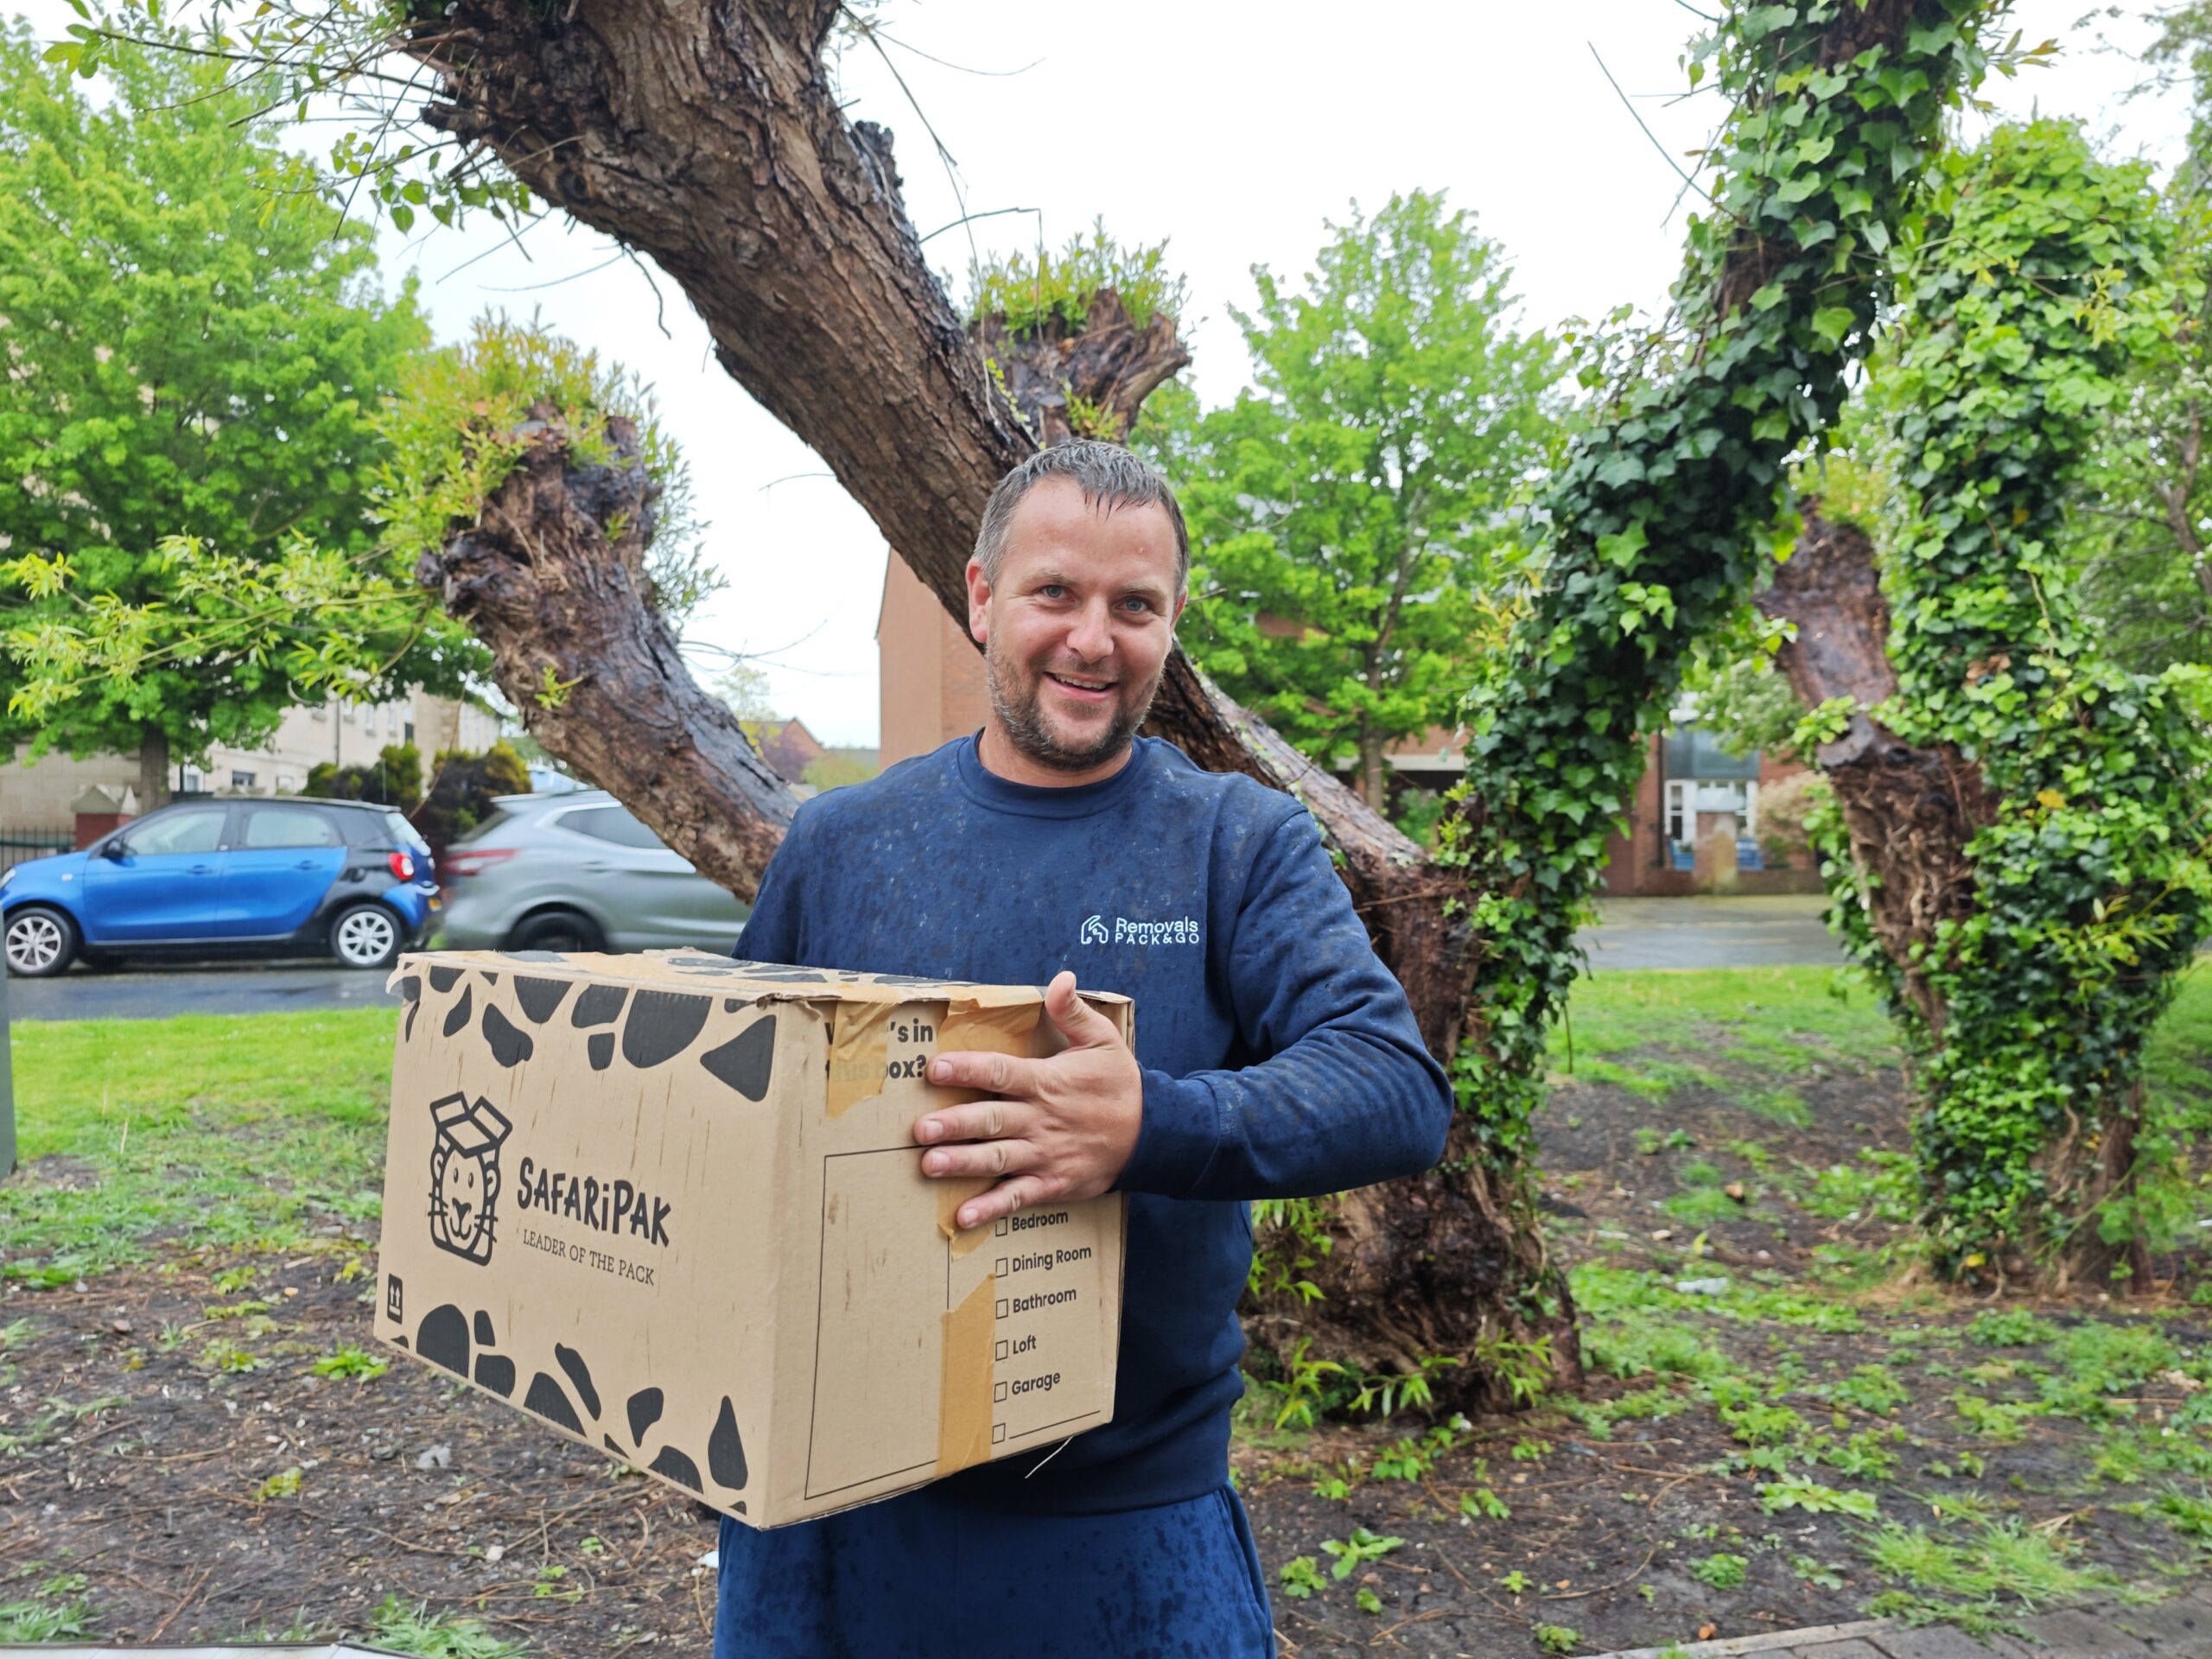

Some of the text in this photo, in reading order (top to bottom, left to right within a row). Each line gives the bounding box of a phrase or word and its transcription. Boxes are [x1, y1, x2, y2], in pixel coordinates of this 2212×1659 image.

[1116, 916, 1198, 934] Removals
[1116, 932, 1199, 944] PACK&GO
[913, 1018, 933, 1042] in
[1012, 1211, 1068, 1232] Bedroom
[523, 1229, 654, 1286] LEADER OF THE PACK
[1013, 1246, 1091, 1273] Dining Room
[1013, 1288, 1077, 1313] Bathroom
[1013, 1335, 1037, 1355] Loft
[1012, 1372, 1060, 1395] Garage
